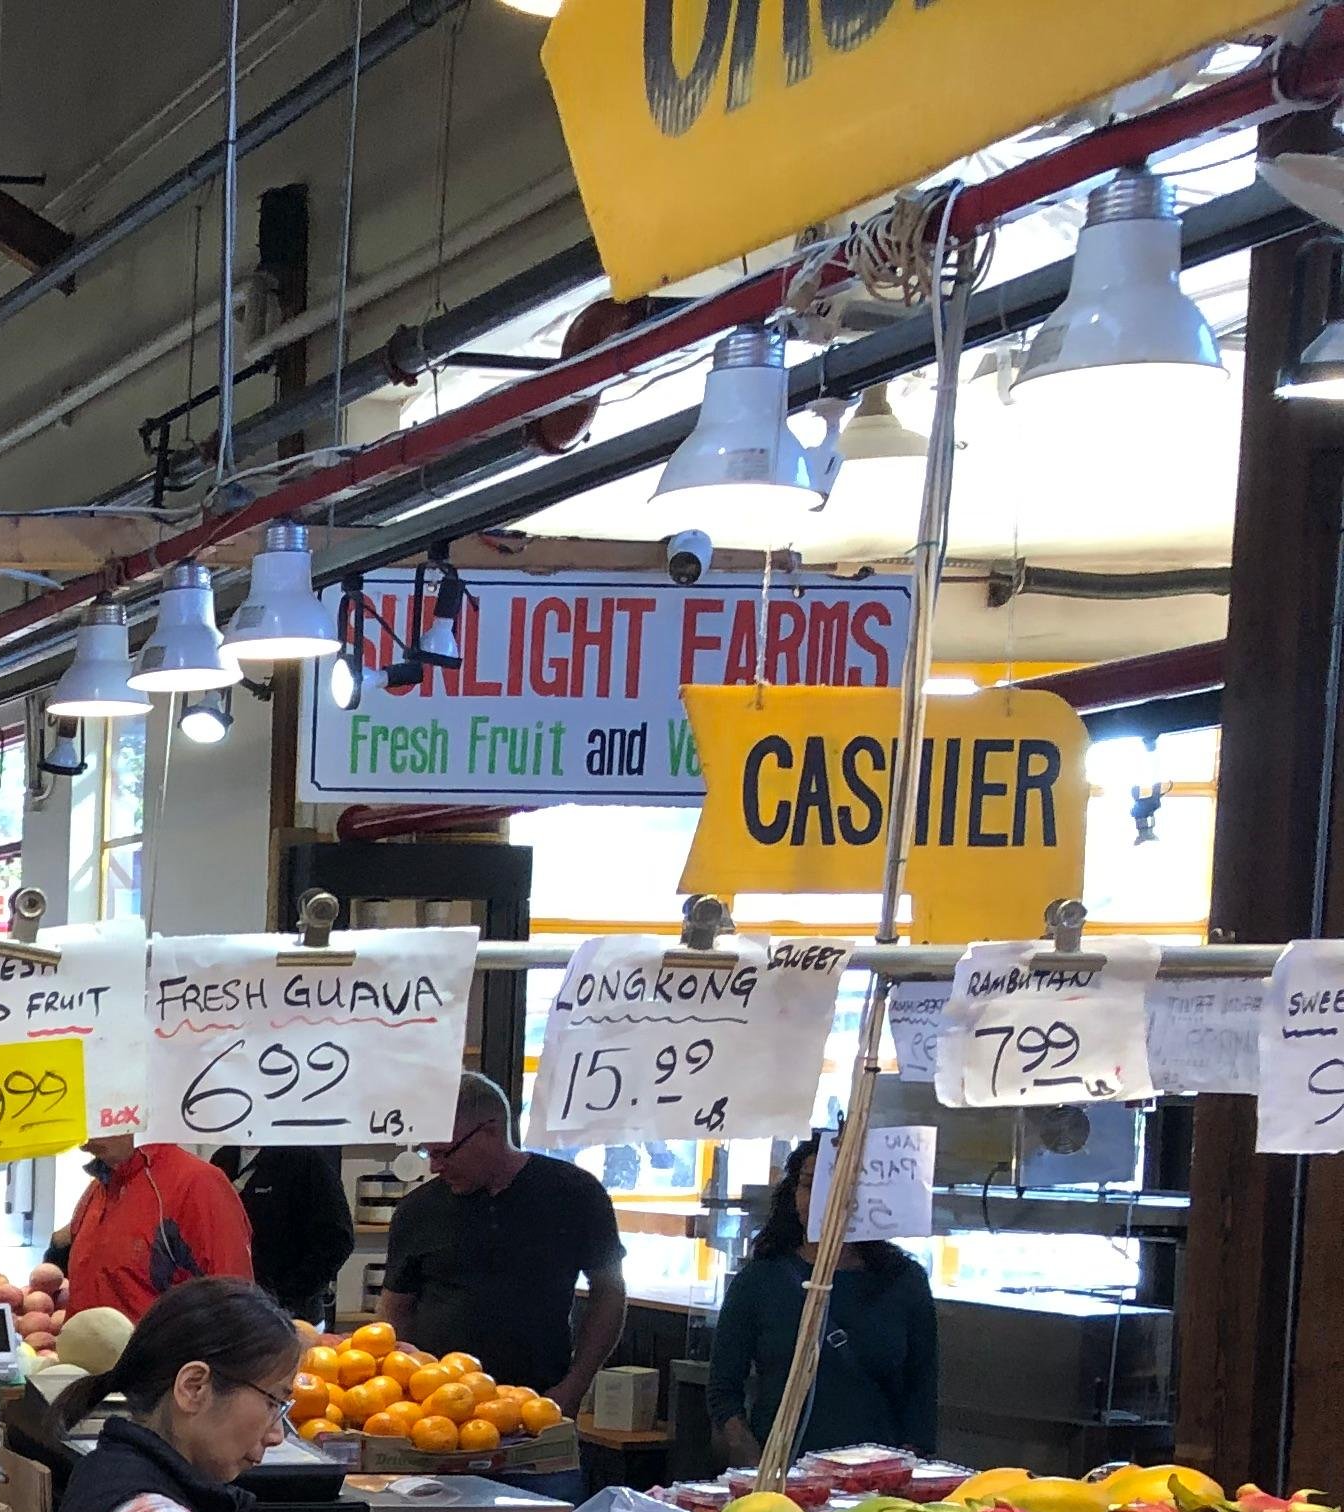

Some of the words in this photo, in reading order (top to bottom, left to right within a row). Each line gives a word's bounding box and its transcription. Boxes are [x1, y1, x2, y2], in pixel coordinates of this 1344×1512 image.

[680, 599, 892, 690] FARMS
[349, 715, 448, 775] Fresh
[468, 715, 567, 776] Fruit
[586, 721, 648, 777] and
[26, 986, 111, 1020] FRUIT
[156, 975, 267, 1021] FRESH
[284, 974, 443, 1016] GUAVA
[966, 967, 1095, 997] RAMBUTAN
